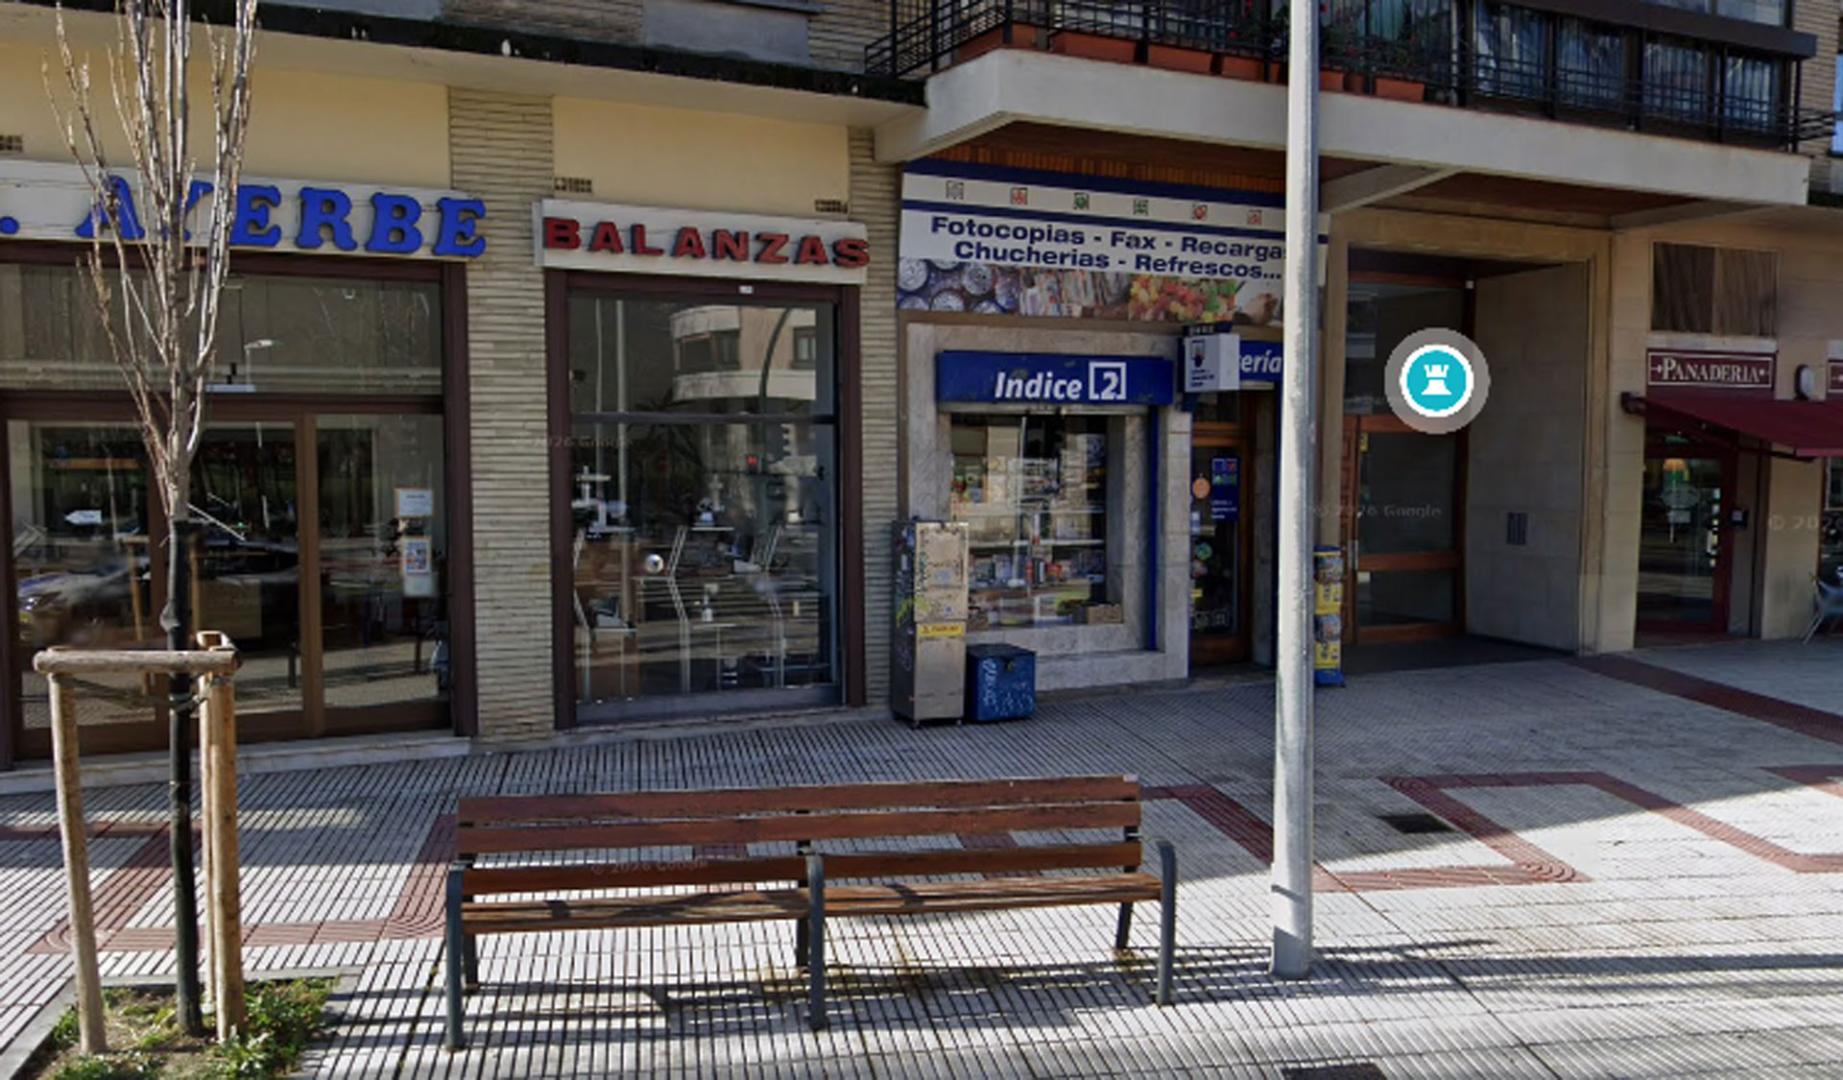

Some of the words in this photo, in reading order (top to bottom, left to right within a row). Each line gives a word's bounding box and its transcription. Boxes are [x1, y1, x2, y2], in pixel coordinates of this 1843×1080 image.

[543, 217, 870, 268] BALANZAS
[931, 216, 1085, 245] Fotocopias
[1111, 231, 1156, 250] Fax
[1181, 236, 1286, 263] Recarga
[954, 241, 1110, 268] Chucherias
[1135, 254, 1282, 280] Refrescos...
[1239, 350, 1283, 374] ería
[1661, 356, 1761, 383] PANADERIA
[995, 371, 1083, 399] Indice
